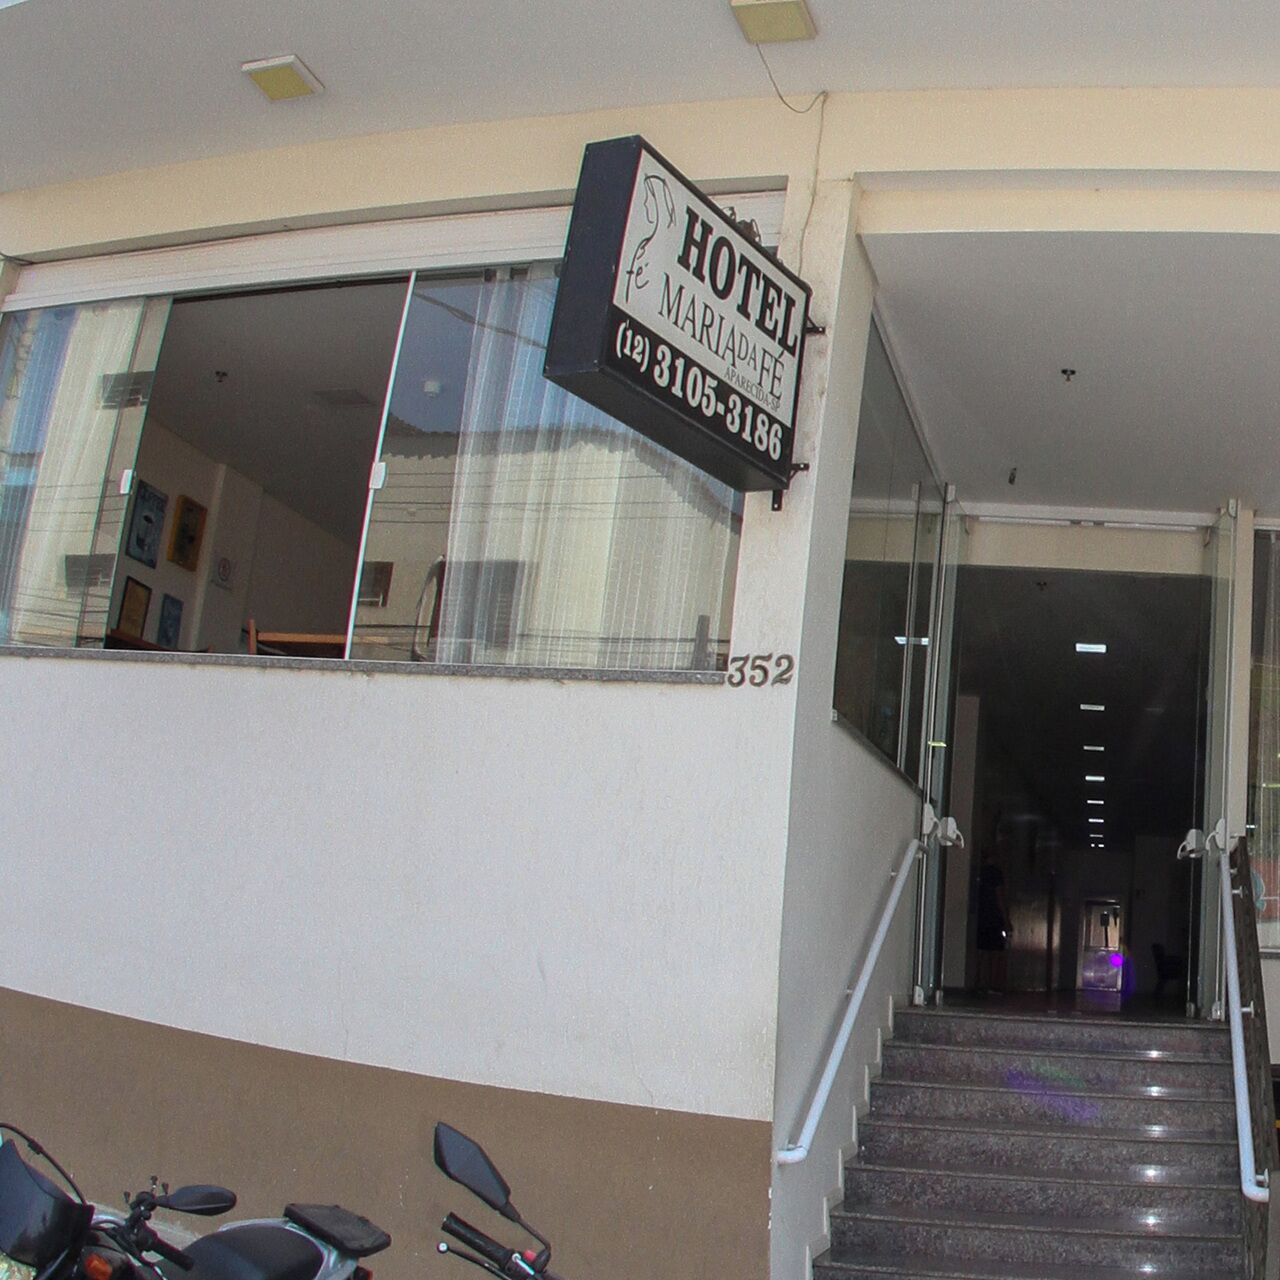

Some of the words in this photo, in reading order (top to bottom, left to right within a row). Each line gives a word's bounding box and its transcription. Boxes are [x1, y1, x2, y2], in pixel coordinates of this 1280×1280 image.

[657, 271, 739, 369] MARIA
[757, 349, 786, 401] FÉ
[677, 205, 798, 358] HOTEL
[615, 320, 651, 373] (12)
[653, 343, 783, 462] 3105-3186
[724, 367, 781, 412] APARECIDA-SP
[727, 653, 795, 688] 352
